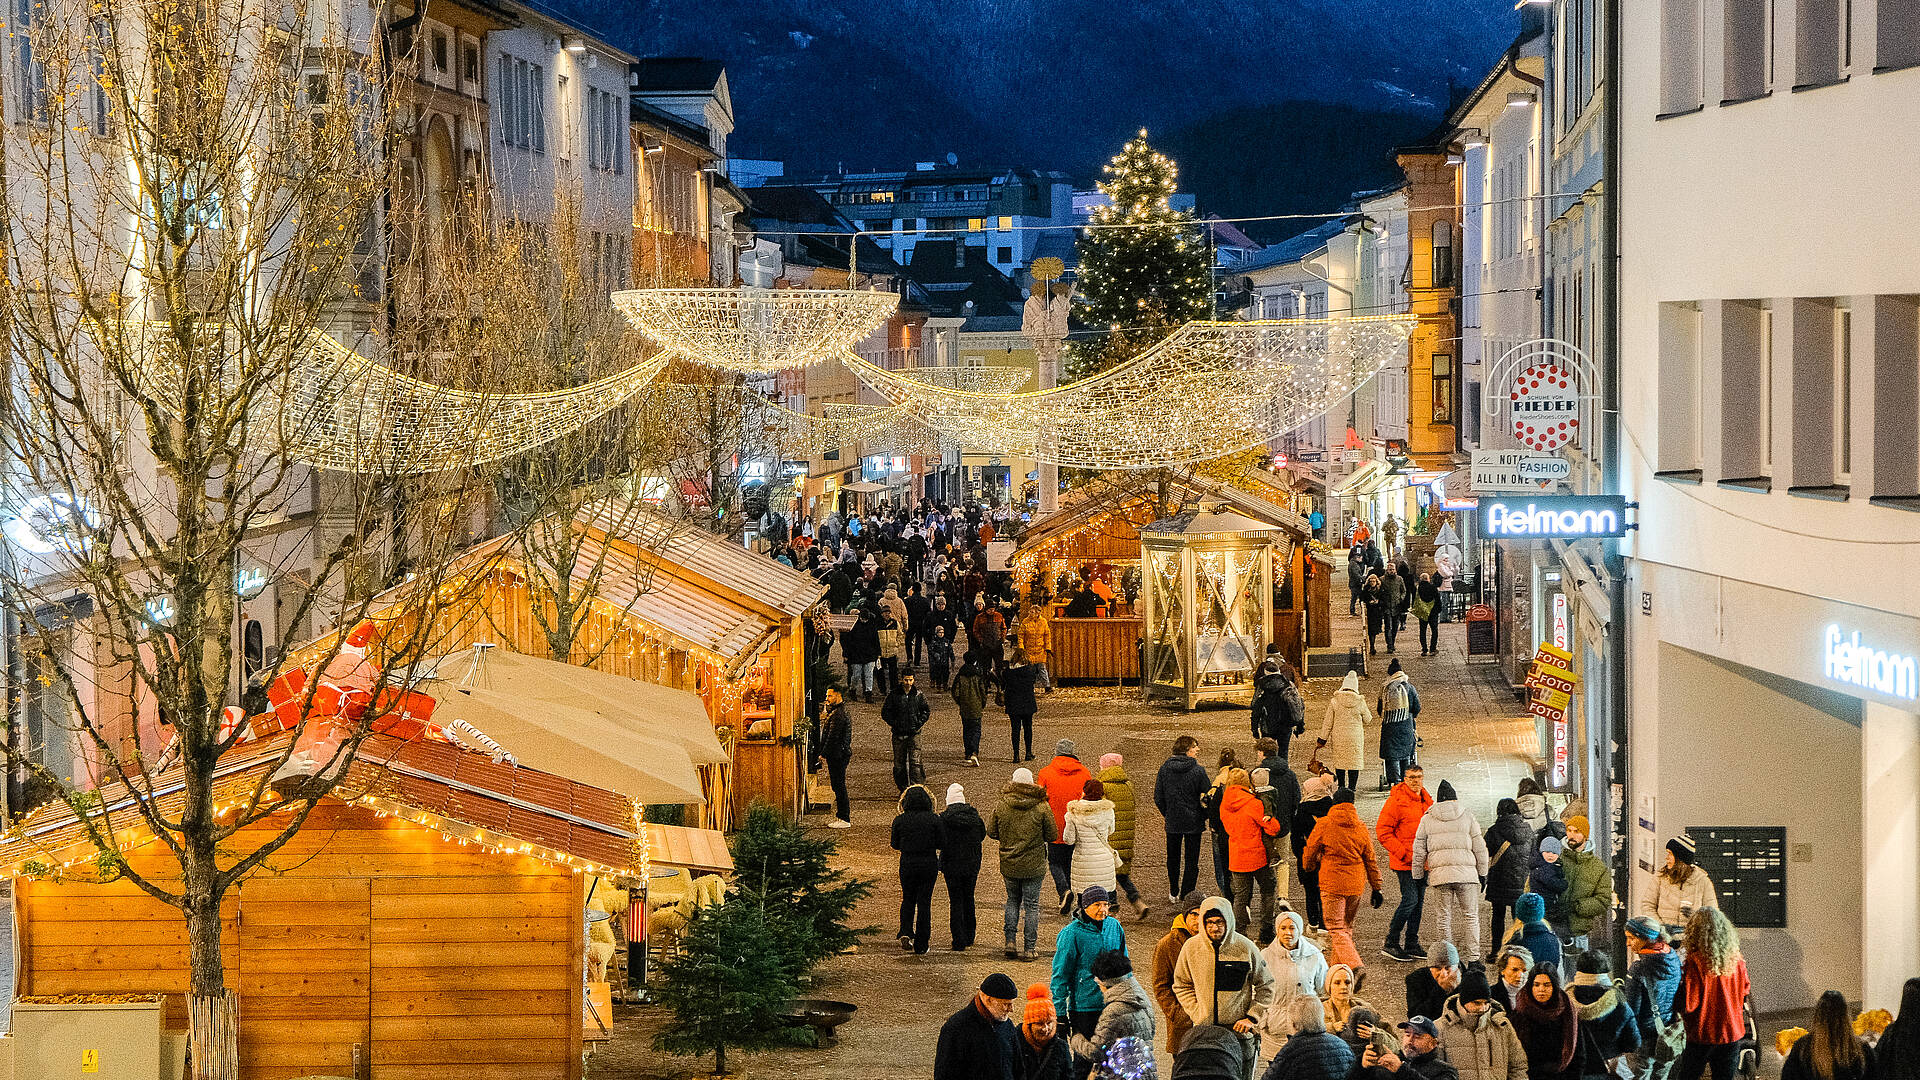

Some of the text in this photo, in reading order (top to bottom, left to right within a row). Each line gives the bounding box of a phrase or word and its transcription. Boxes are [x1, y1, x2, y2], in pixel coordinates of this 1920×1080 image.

[1514, 400, 1577, 411] RIEDER
[1520, 463, 1568, 473] FASHION
[1477, 474, 1493, 484] ALL
[1496, 474, 1507, 484] IN
[1488, 503, 1617, 534] fielmann
[1536, 651, 1567, 669] FOTO
[1825, 623, 1918, 700] fielmann
[1540, 674, 1572, 692] FOTO
[1529, 702, 1562, 720] FOTO
